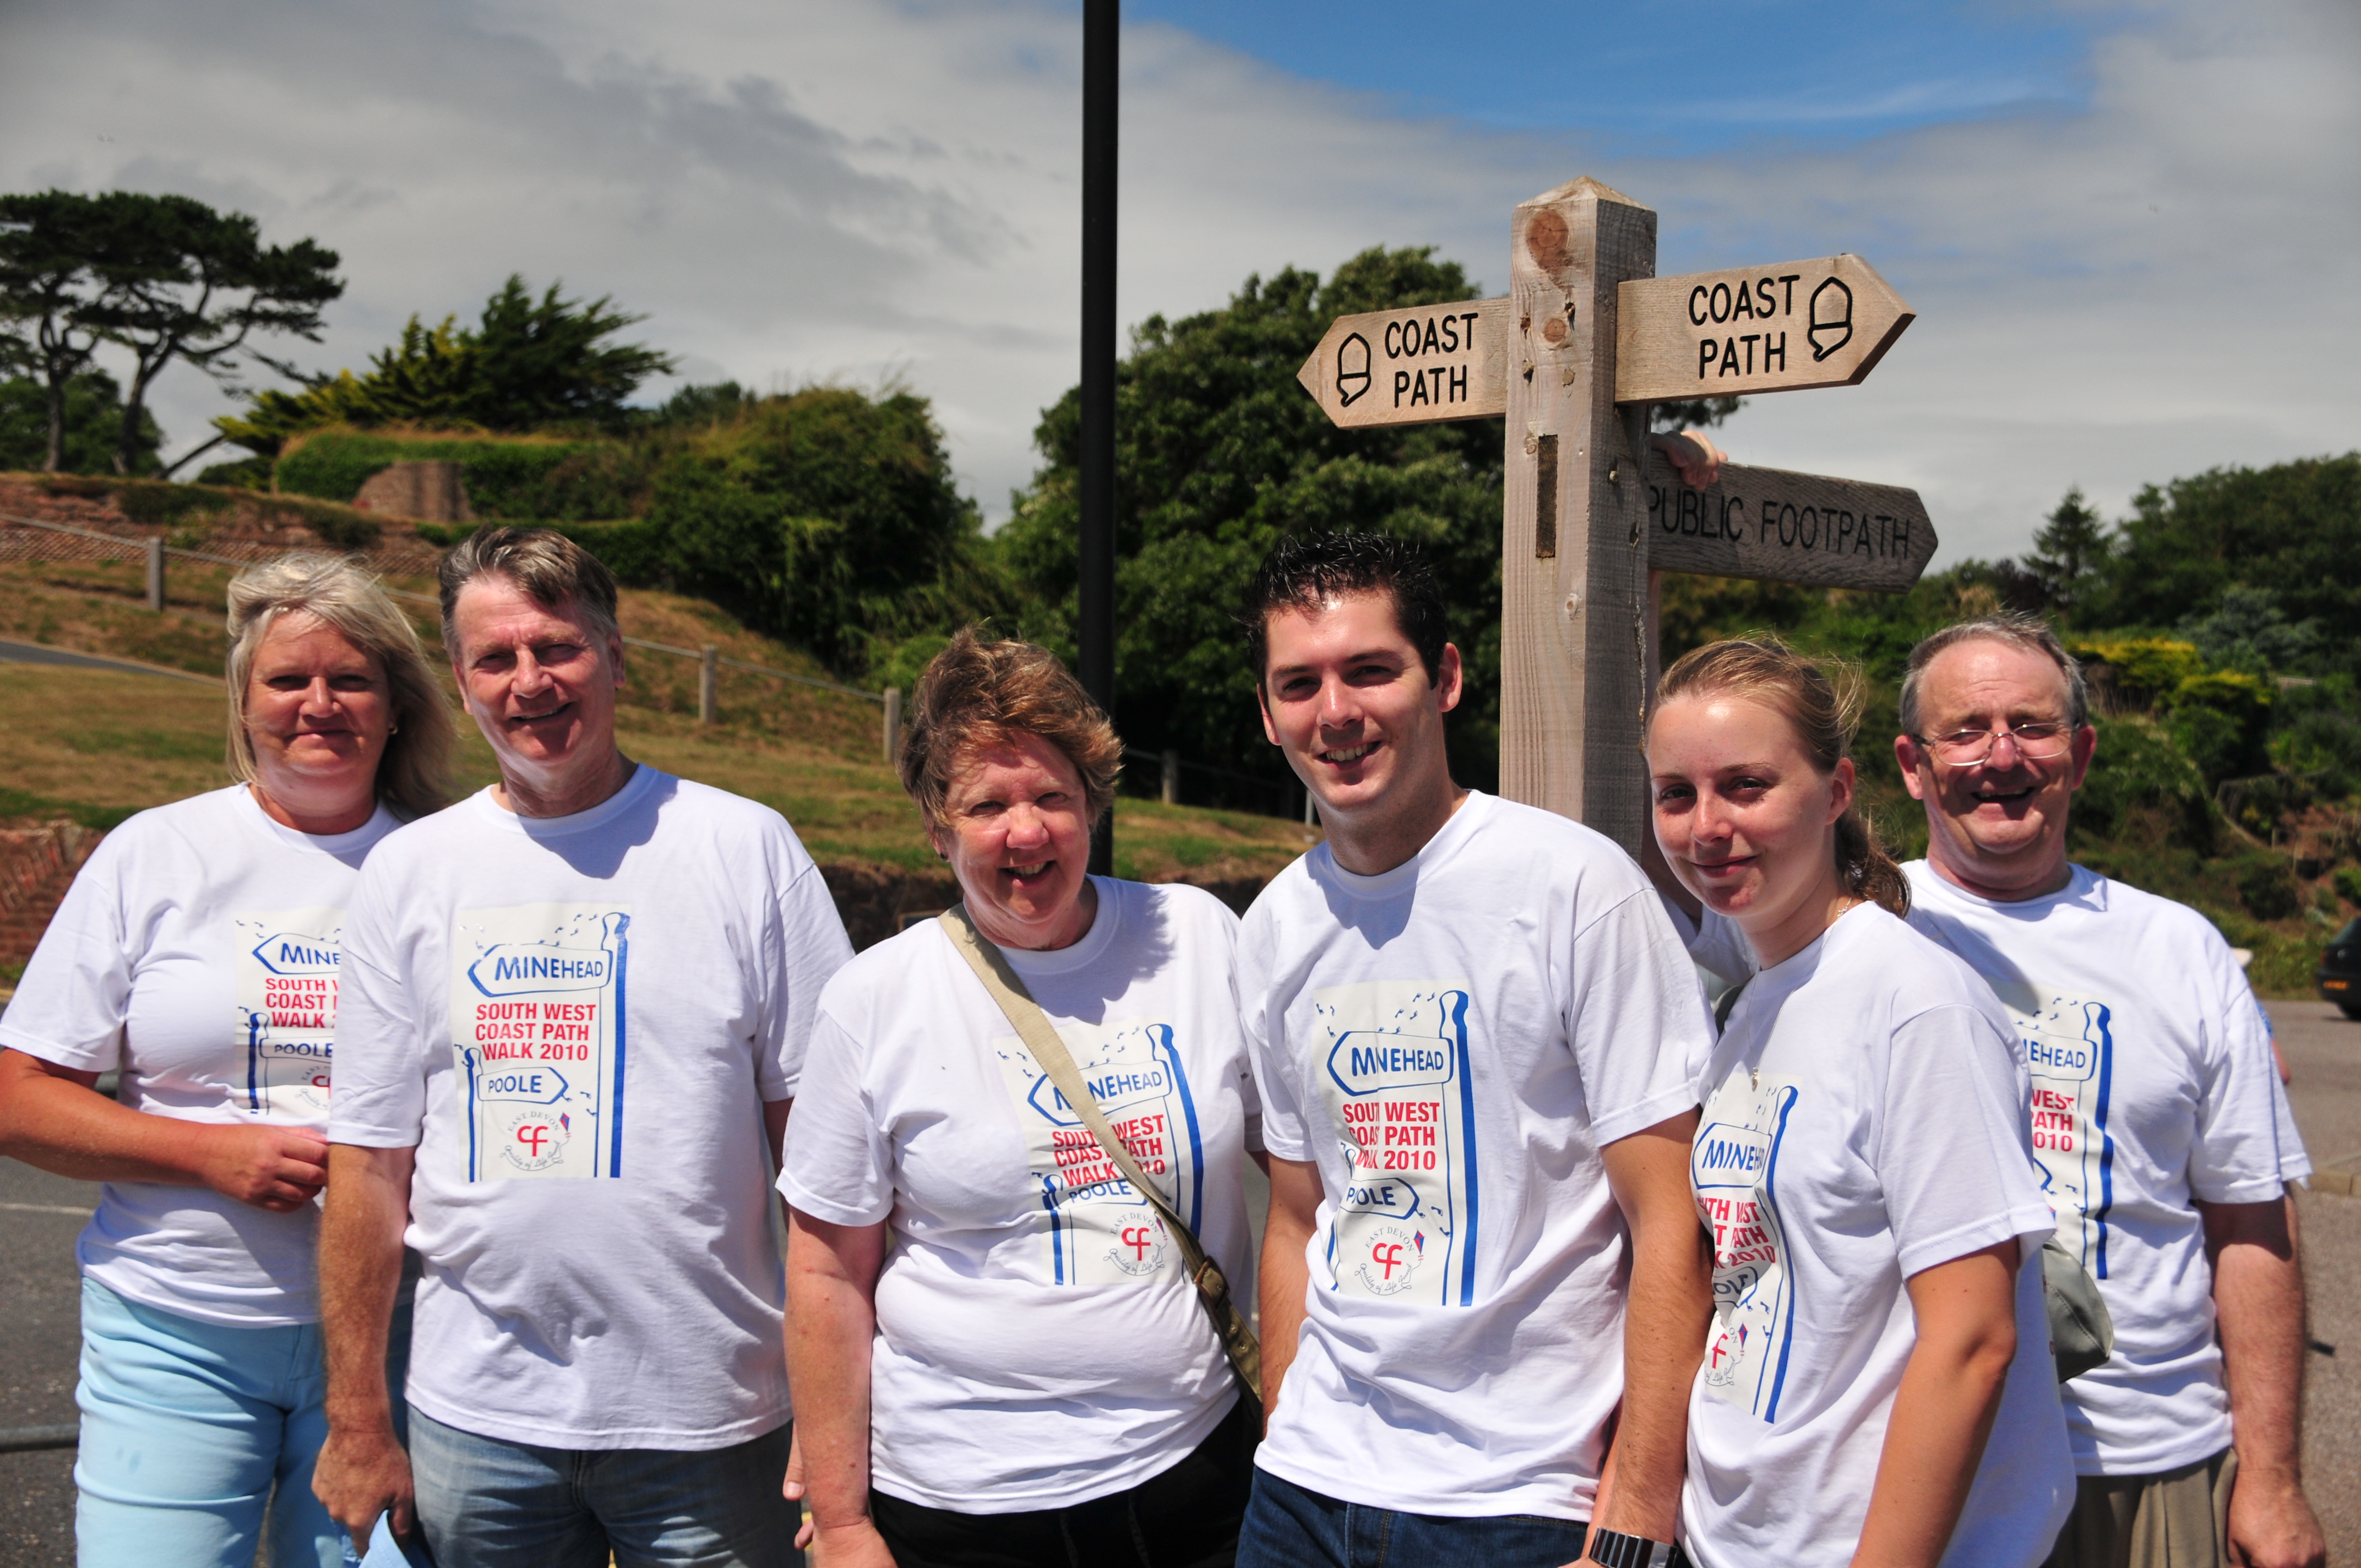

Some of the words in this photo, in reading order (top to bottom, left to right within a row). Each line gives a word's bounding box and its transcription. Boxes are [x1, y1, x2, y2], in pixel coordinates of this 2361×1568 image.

[1688, 274, 1800, 326] COAST
[1384, 313, 1479, 359] COAST
[1699, 331, 1786, 380] PATH
[1394, 364, 1468, 408] PATH
[1649, 485, 1744, 541] PUBLIC
[1761, 500, 1910, 559] FOOTPATH
[495, 956, 603, 981] MINEHEAD
[265, 978, 326, 991] SOUTH
[266, 993, 326, 1010] COAST
[476, 1003, 537, 1021] SOUTH
[543, 1003, 596, 1021] WEST
[272, 1011, 325, 1028] WALK
[476, 1023, 536, 1041] COAST
[542, 1024, 589, 1041] PATH
[481, 1042, 534, 1061] WALK
[540, 1043, 588, 1061] 2010
[488, 1075, 542, 1093] POOLE
[507, 1113, 526, 1132] EAST
[530, 1111, 561, 1131] DEVON
[1384, 1102, 1440, 1122] WEST
[1111, 1114, 1164, 1140] WEST
[1384, 1126, 1435, 1146] PATH
[1384, 1150, 1436, 1170] 2010
[1062, 1162, 1118, 1187] WALK
[1068, 1179, 1132, 1204] POOLE
[1110, 1215, 1127, 1235] EAST
[1129, 1212, 1158, 1233] DEVON
[1365, 1228, 1384, 1248] EAST
[1387, 1226, 1415, 1251] DEVON
[1727, 1245, 1776, 1267] 2010
